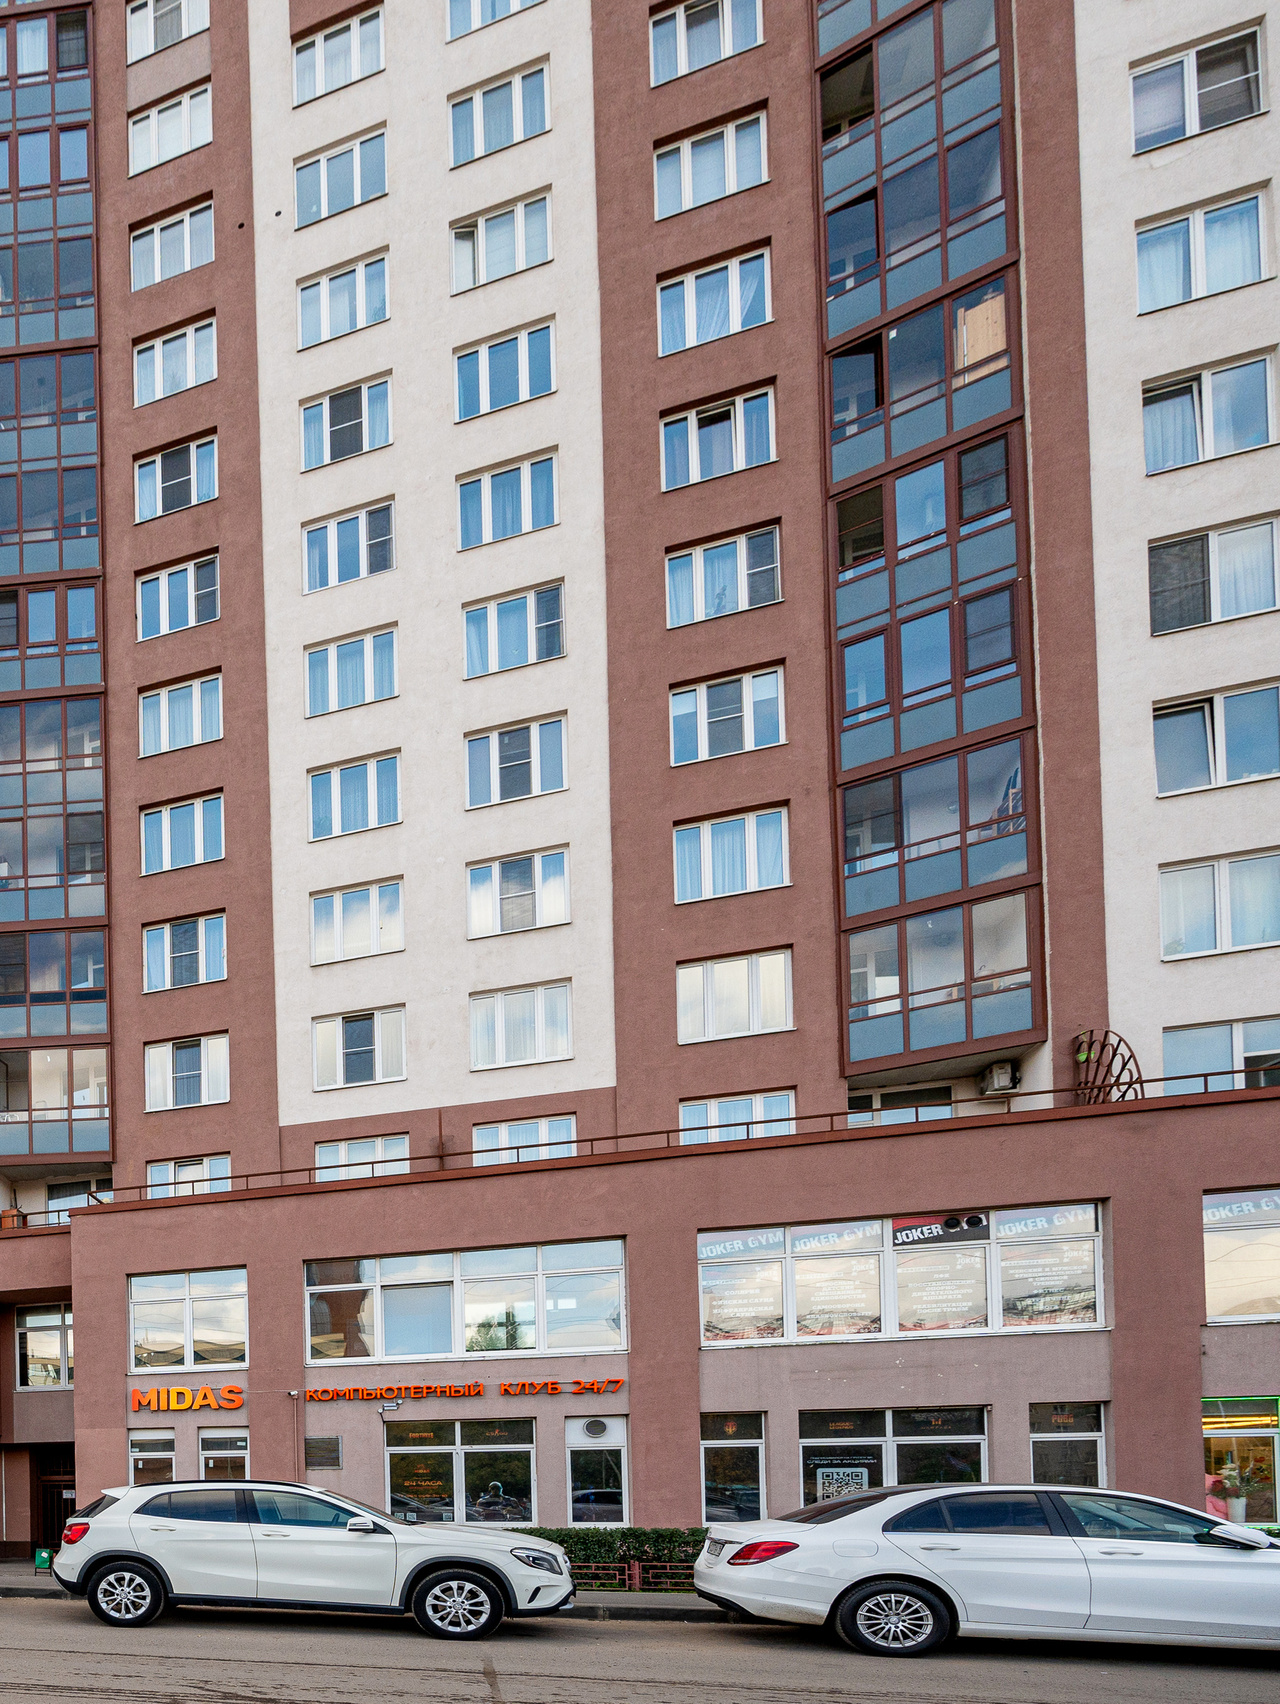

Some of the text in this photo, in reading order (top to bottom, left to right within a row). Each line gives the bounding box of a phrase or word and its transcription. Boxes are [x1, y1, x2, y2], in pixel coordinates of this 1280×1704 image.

[997, 1217, 1048, 1237] JOKER
[1053, 1207, 1095, 1226] GYM
[700, 1231, 784, 1258] JOKER GYM
[793, 1224, 882, 1252] JOKER GYM
[894, 1223, 944, 1244] JOKER
[957, 1257, 981, 1265] JOKER
[1064, 1250, 1089, 1258] JOKER
[132, 1385, 244, 1412] MIDAS
[306, 1379, 625, 1401] КОМПЬЮТЕРНЫЙ КЛУБ 24/7
[1051, 1414, 1074, 1423] PUBG
